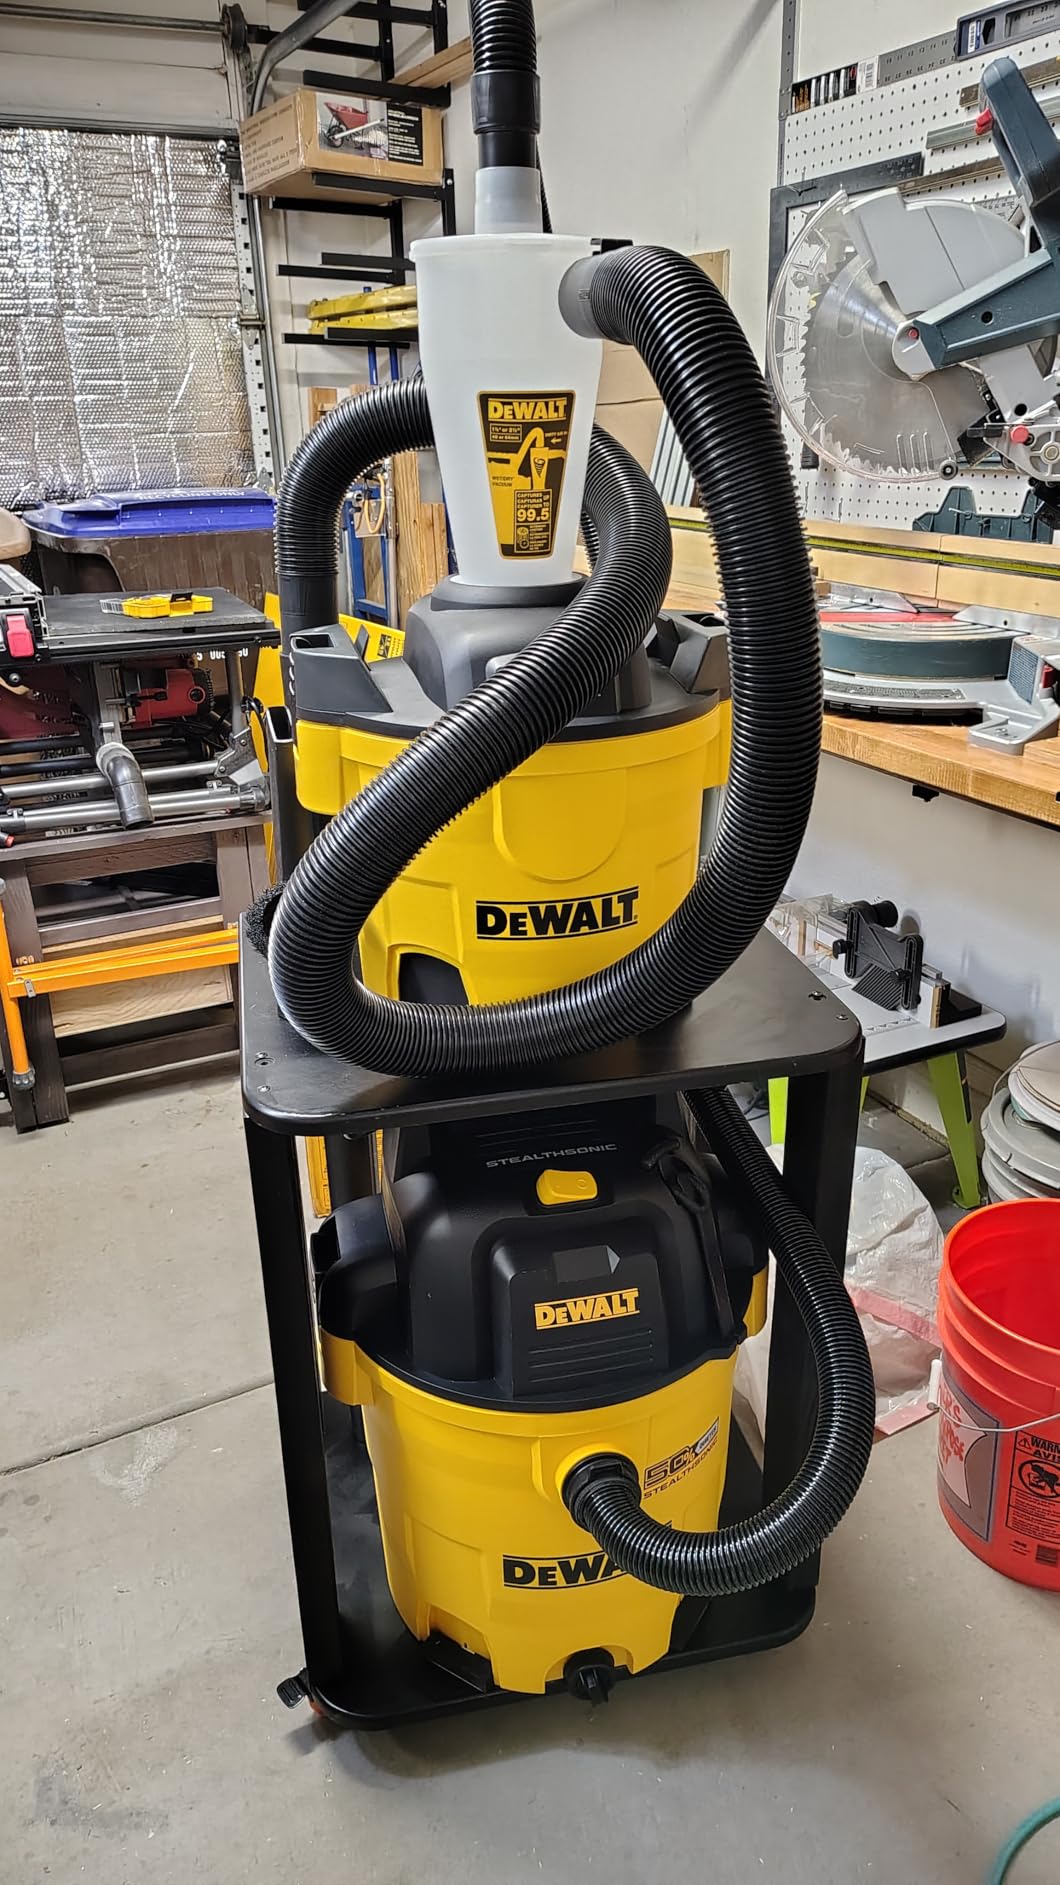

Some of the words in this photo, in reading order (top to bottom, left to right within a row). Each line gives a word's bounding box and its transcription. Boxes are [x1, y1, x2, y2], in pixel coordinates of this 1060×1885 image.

[517, 508, 550, 522] 99.5
[486, 1143, 617, 1168] STEALTHSONIC
[643, 1436, 718, 1499] STEALTHSONIC
